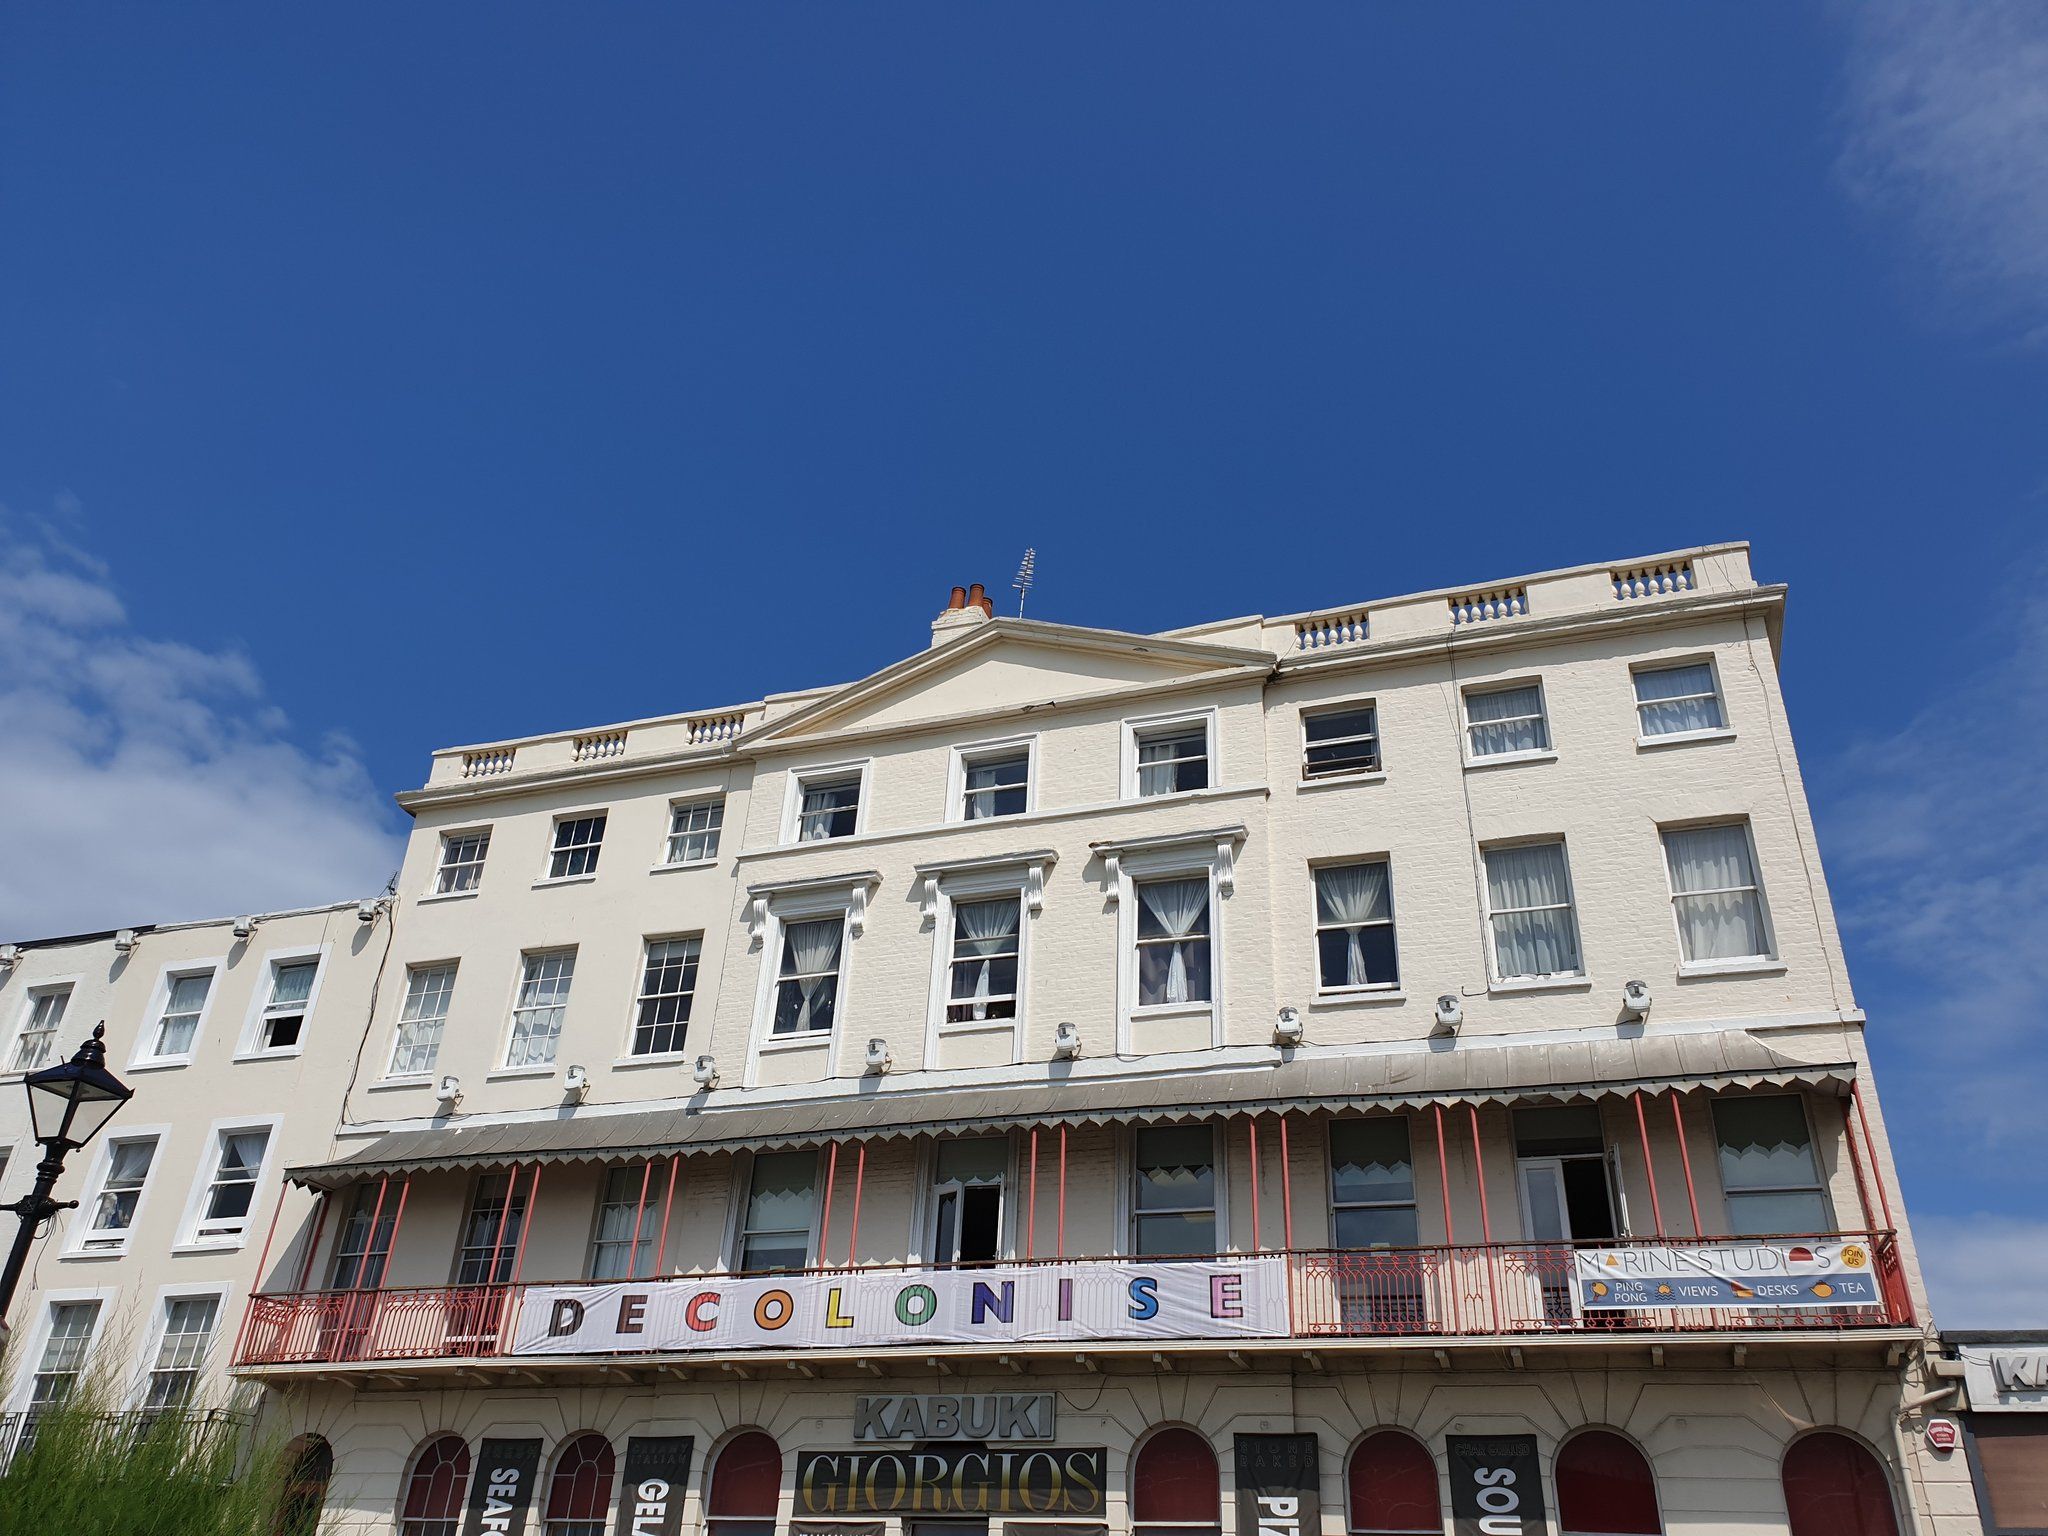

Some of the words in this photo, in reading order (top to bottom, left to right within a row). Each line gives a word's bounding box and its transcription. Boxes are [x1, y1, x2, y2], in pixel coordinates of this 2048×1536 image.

[1842, 1248, 1863, 1259] JOIN
[1847, 1257, 1860, 1266] US
[1615, 1281, 1643, 1293] PING
[1678, 1285, 1719, 1297] VIEWS
[1757, 1284, 1800, 1296] DESKS
[1838, 1282, 1866, 1295] TEA
[1614, 1292, 1648, 1303] PONG
[547, 1273, 1244, 1338] DECOLONISE
[853, 1395, 1054, 1438] KABUKI
[1240, 1440, 1313, 1454] STONE
[1240, 1454, 1314, 1468] BAKED
[803, 1451, 1100, 1513] GIORGIOS
